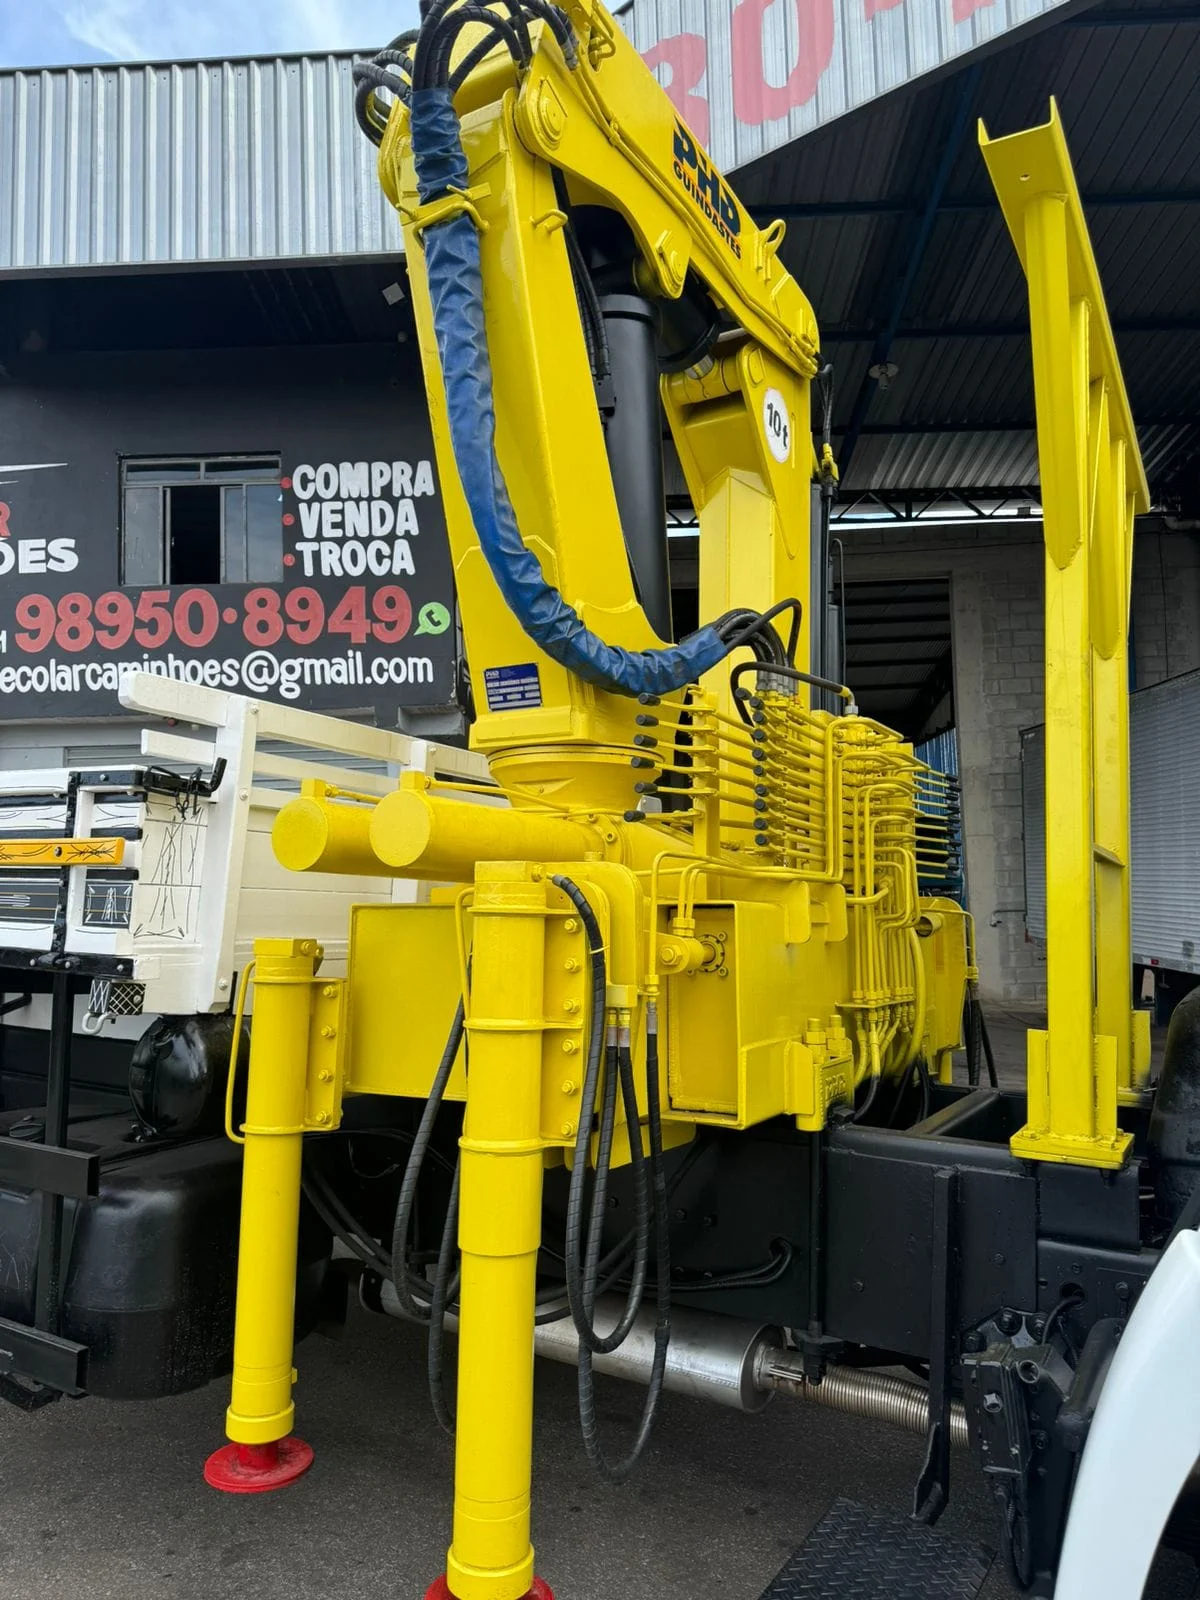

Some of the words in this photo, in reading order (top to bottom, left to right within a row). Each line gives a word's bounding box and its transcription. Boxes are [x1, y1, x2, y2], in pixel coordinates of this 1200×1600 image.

[673, 114, 741, 237] PHD
[673, 160, 741, 260] GUINDASTES
[292, 460, 435, 500] COMPRA
[298, 498, 419, 539] VENDA
[295, 538, 416, 577] TROCA
